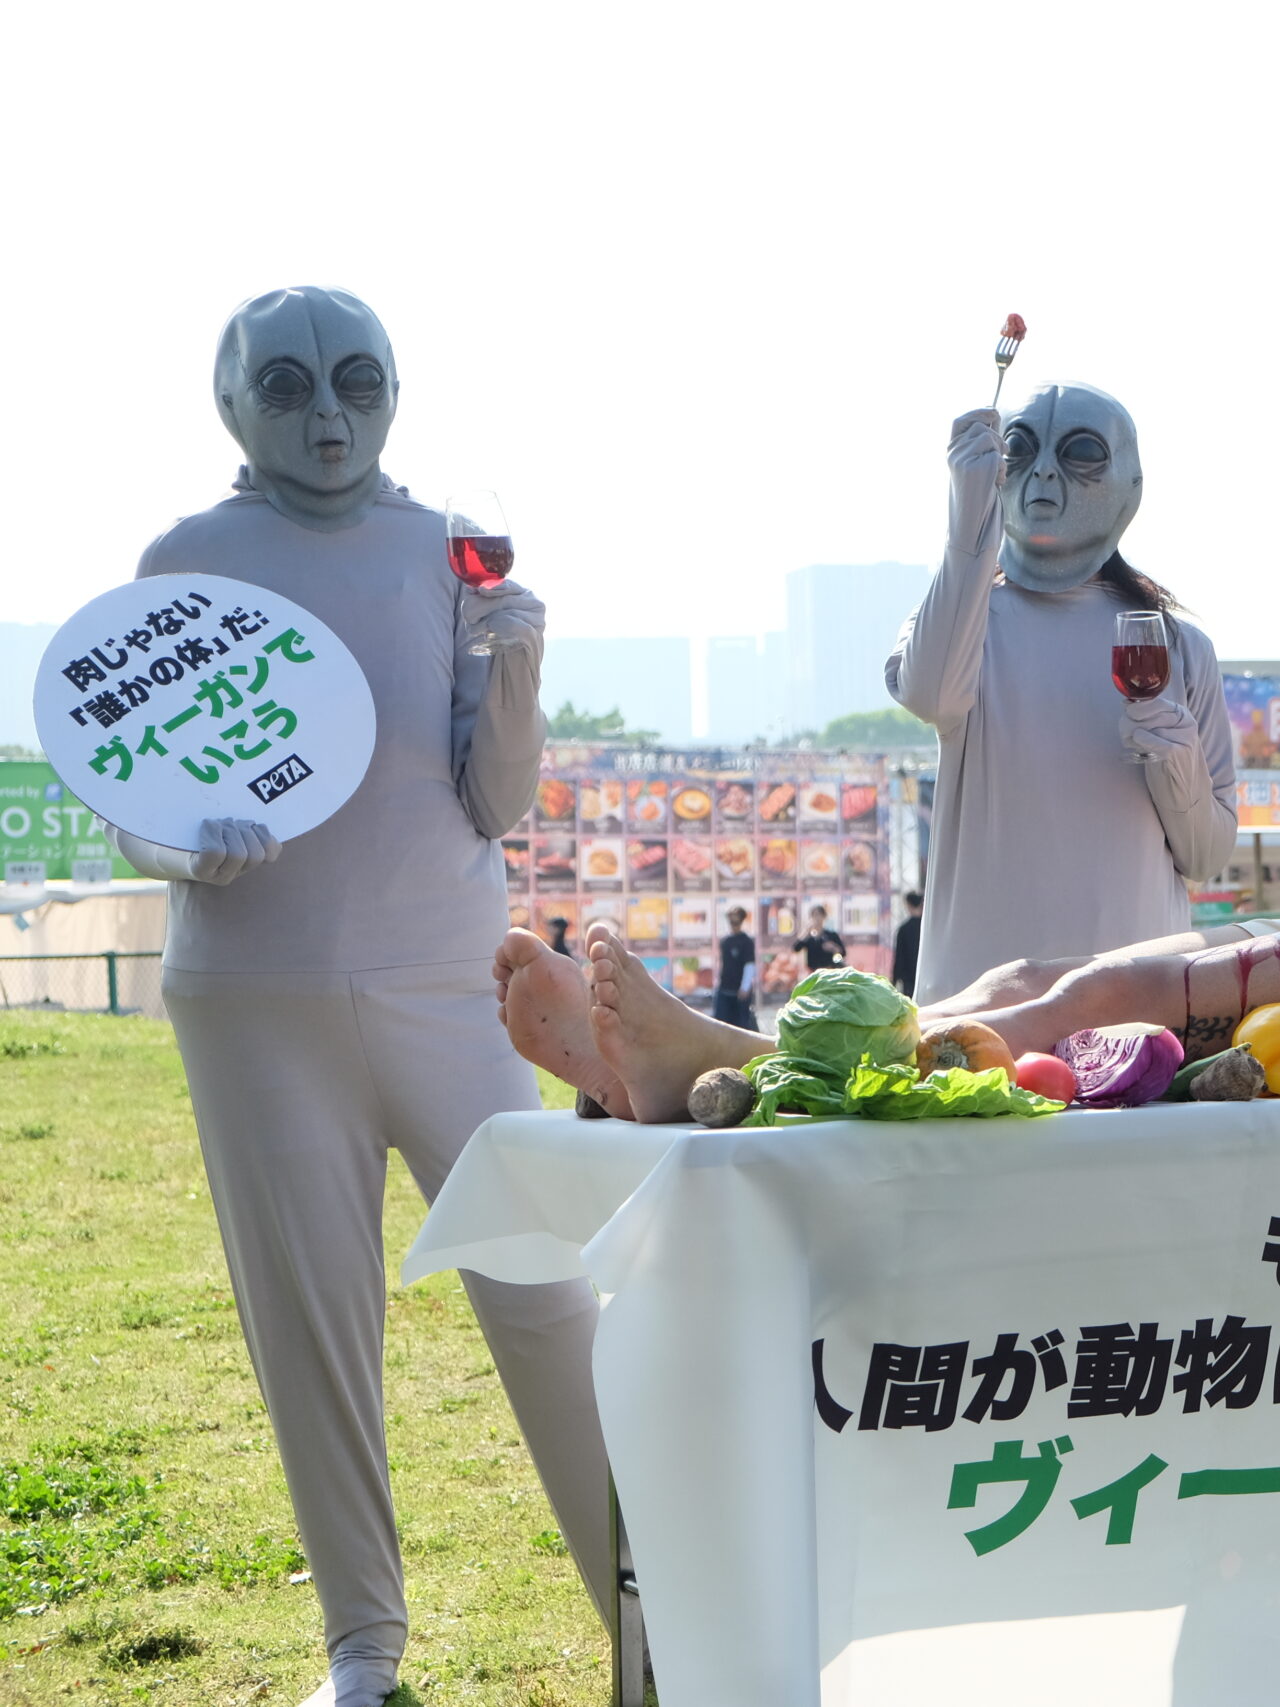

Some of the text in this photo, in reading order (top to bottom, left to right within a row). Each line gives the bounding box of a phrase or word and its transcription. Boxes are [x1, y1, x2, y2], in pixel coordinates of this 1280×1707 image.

[62, 592, 212, 692] 肉じゃない
[88, 627, 316, 782] ヴィーガンで
[180, 700, 297, 784] いこう
